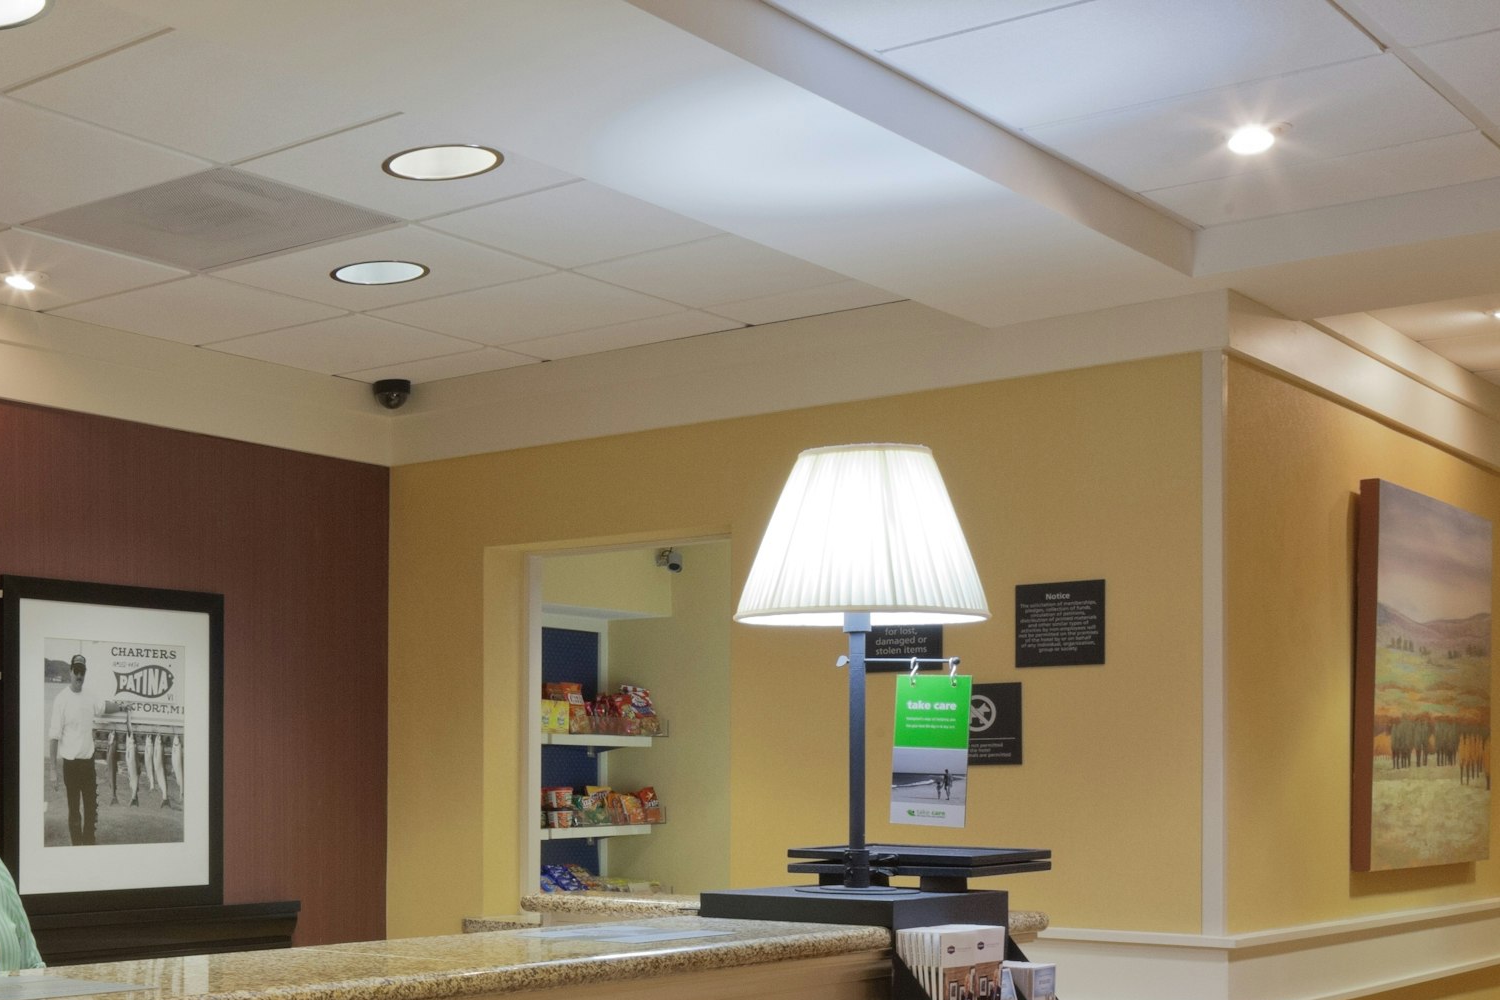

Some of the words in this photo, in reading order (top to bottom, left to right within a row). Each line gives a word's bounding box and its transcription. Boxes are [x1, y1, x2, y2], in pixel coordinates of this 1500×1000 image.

[1045, 592, 1071, 600] Notice
[885, 627, 897, 635] for
[900, 627, 917, 635] lost,
[876, 636, 915, 646] damaged
[111, 646, 177, 660] CHARTERS
[876, 647, 901, 655] stolen
[904, 646, 927, 654] items
[120, 668, 169, 696] PATINA
[907, 700, 931, 710] take
[934, 702, 957, 710] care
